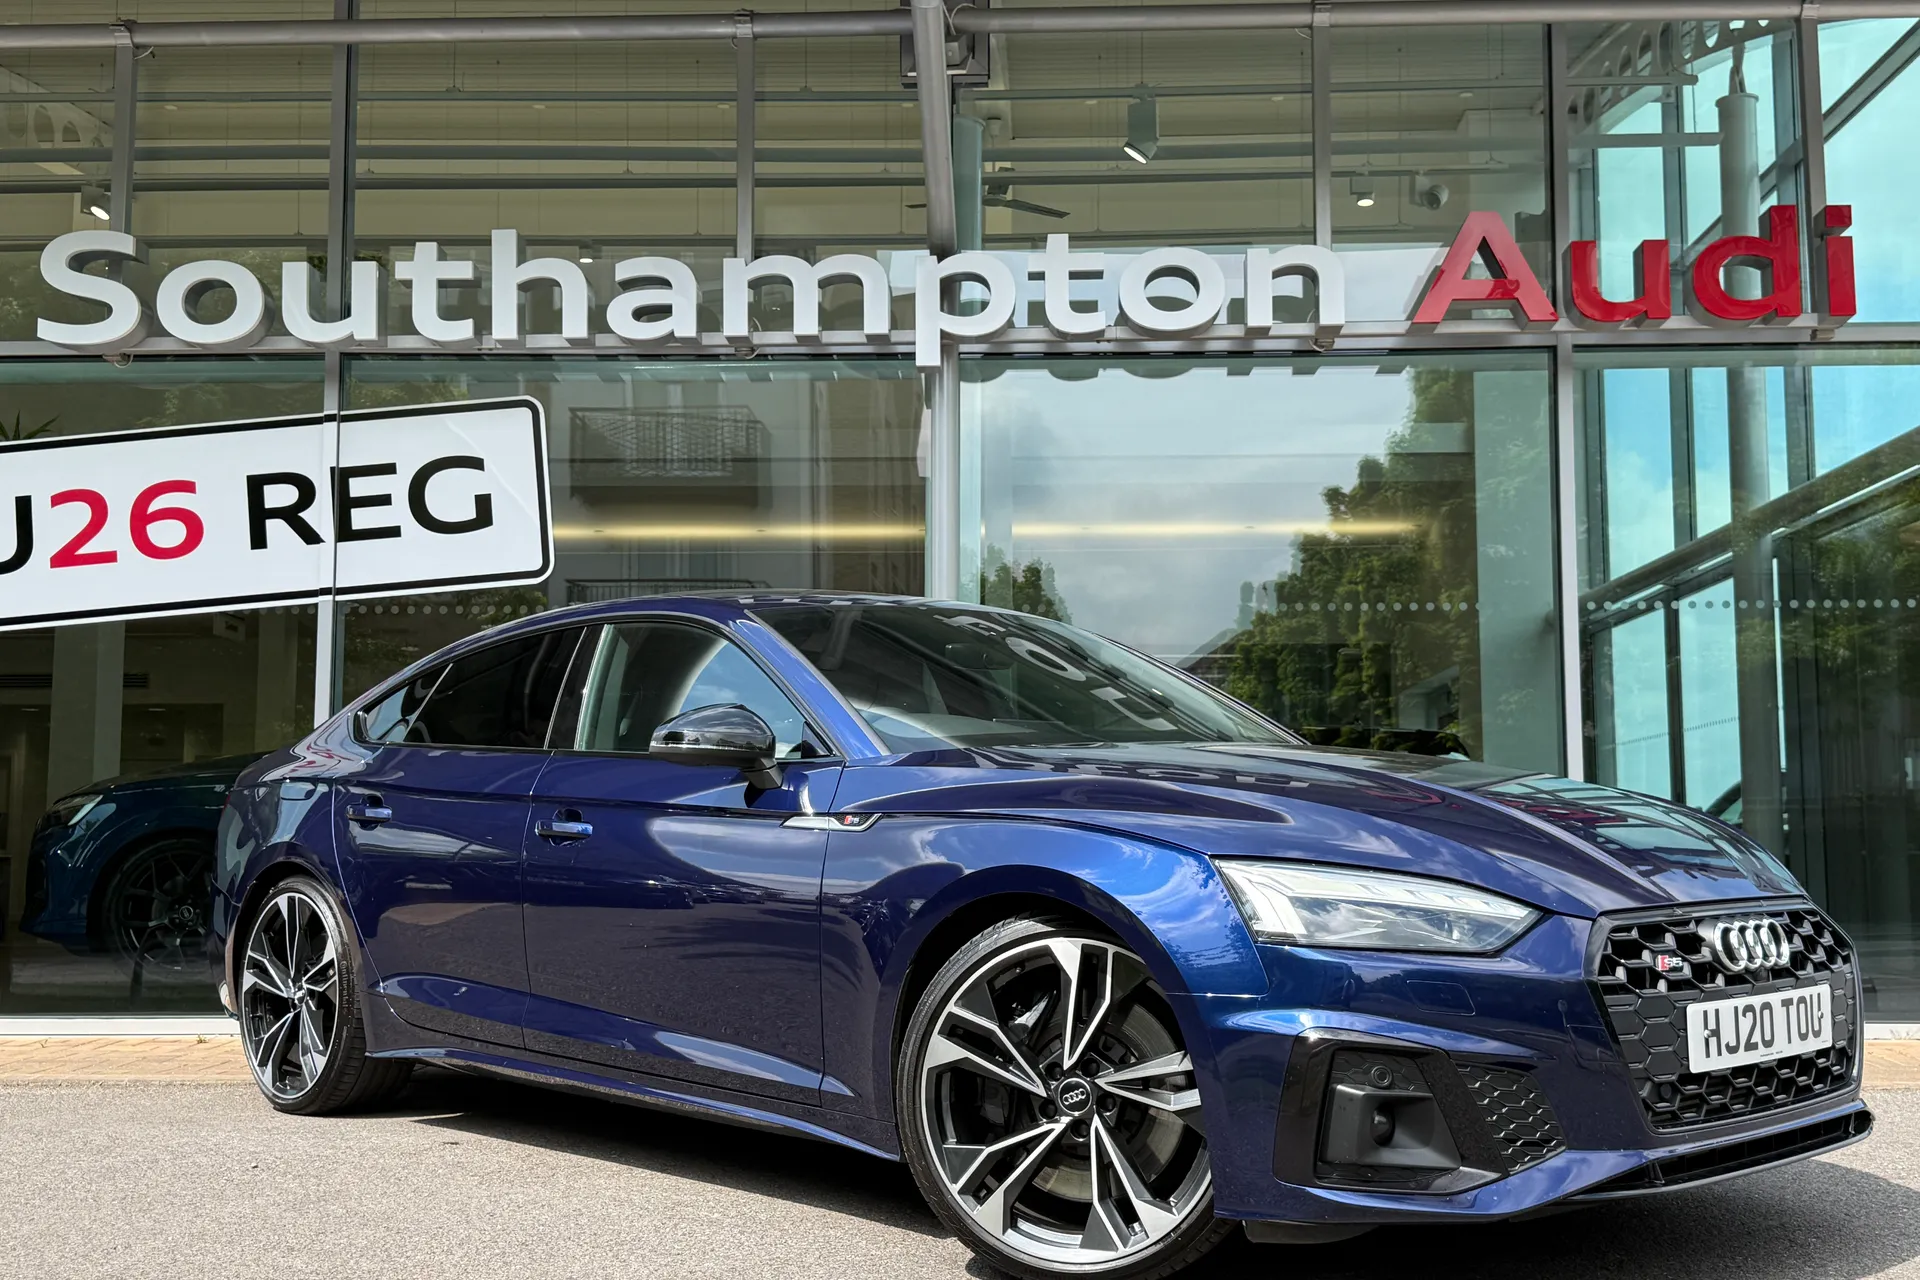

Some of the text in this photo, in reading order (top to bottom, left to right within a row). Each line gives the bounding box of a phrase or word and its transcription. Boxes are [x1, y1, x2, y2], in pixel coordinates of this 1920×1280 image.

[37, 205, 1857, 367] Southampton Audi
[246, 455, 494, 551] REG
[1662, 956, 1683, 968] S5
[1703, 992, 1824, 1058] HJ20 TOU
